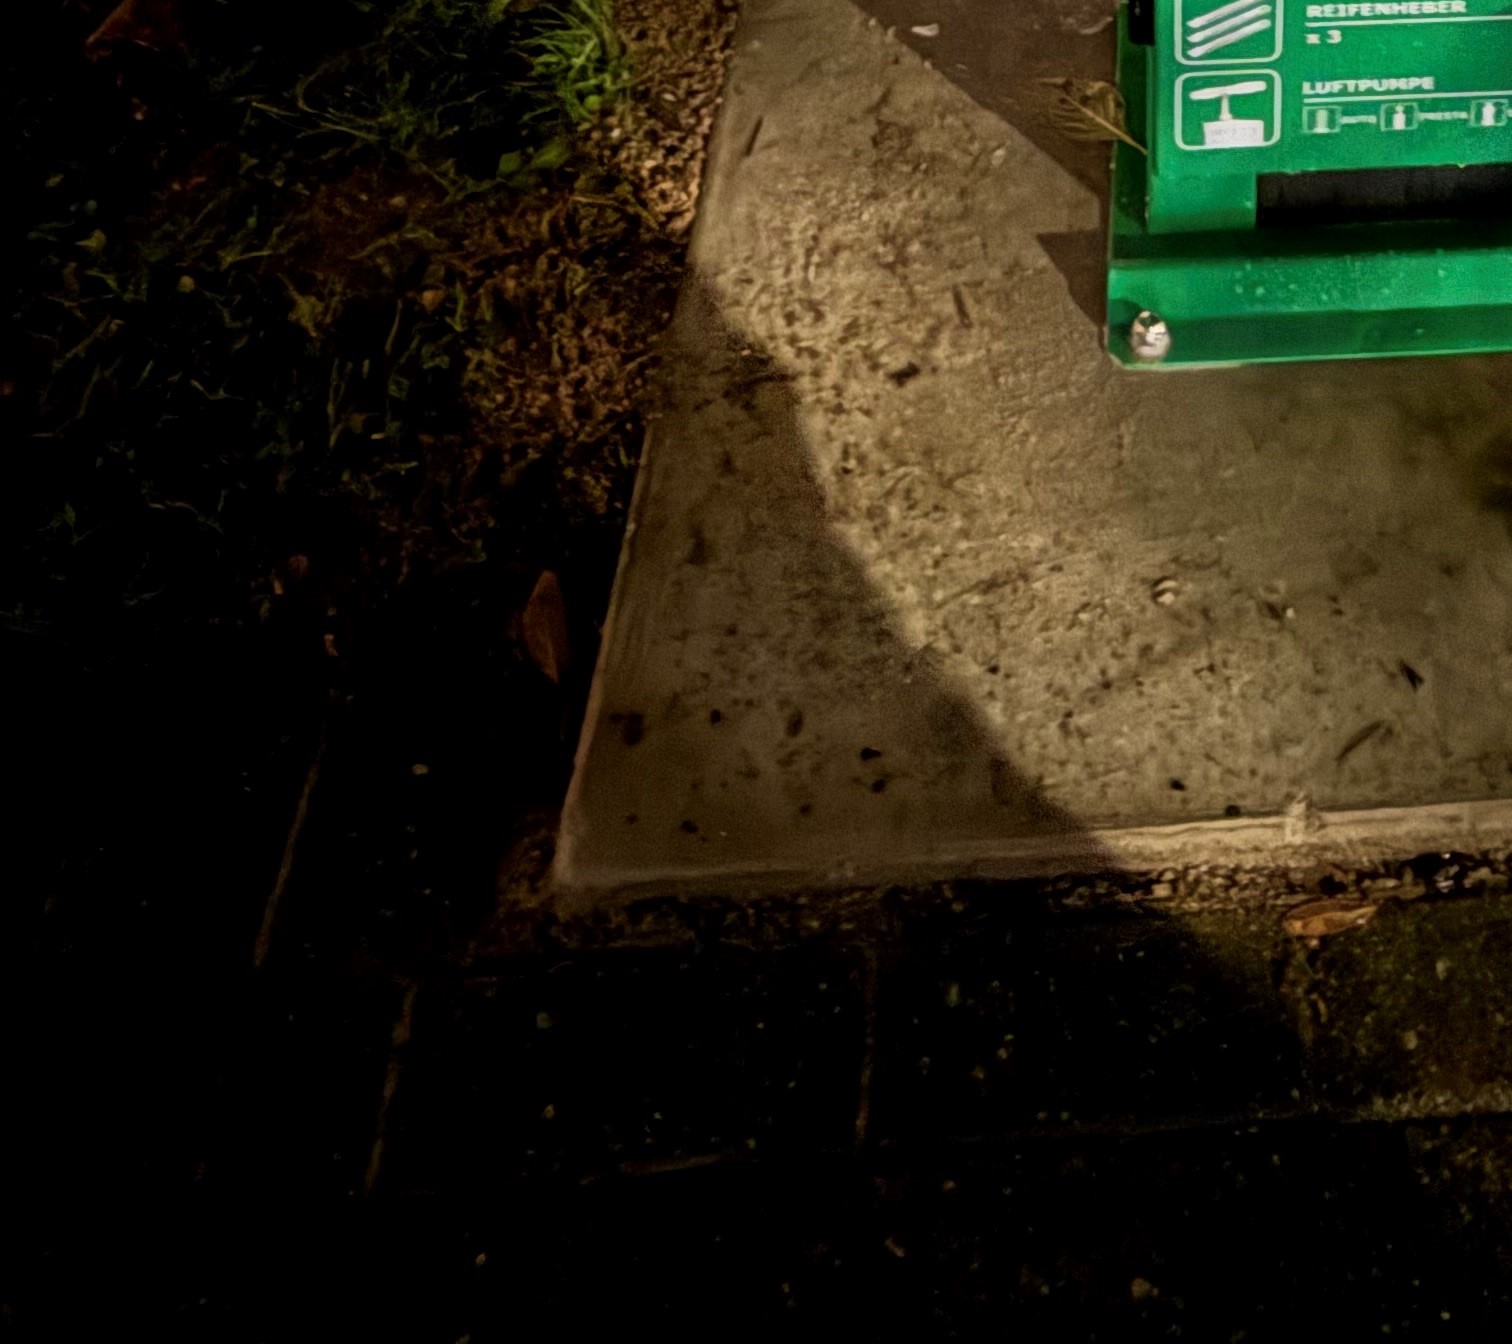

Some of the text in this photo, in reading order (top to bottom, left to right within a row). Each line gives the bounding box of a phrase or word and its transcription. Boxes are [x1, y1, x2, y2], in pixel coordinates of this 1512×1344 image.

[1306, 0, 1467, 18] REIFENHEBER
[1326, 29, 1343, 44] 3
[1302, 76, 1434, 95] LUFTPUMPE
